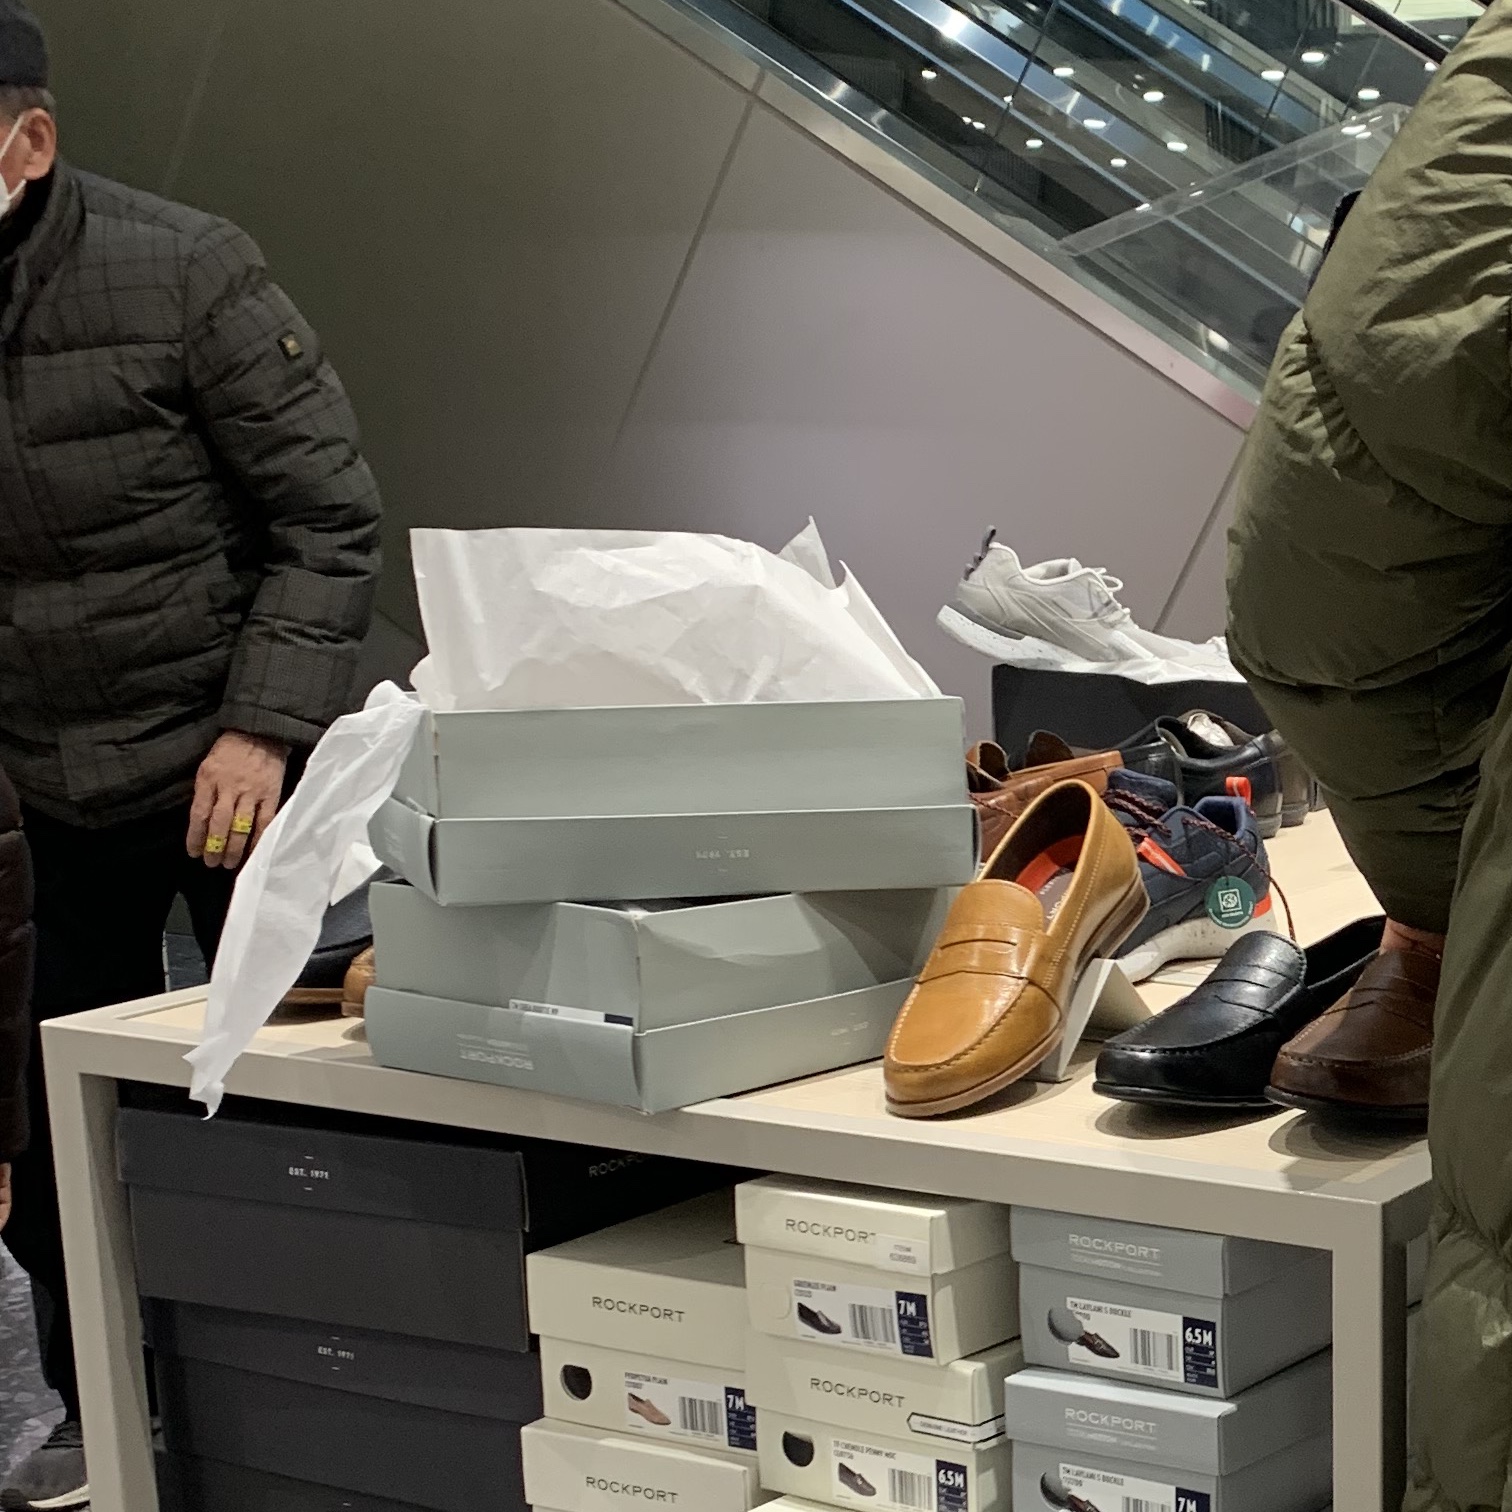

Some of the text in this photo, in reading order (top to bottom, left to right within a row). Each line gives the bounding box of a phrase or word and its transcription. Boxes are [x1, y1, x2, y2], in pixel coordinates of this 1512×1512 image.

[288, 1167, 308, 1177] EST.
[784, 1218, 877, 1244] ROCKPORT
[1068, 1233, 1161, 1260] ROCKPORT
[591, 1296, 686, 1324] ROCKPORT
[897, 1300, 917, 1318] 7M
[810, 1377, 906, 1409] ROCKPORT
[1064, 1407, 1156, 1434] ROCKPORT
[585, 1476, 679, 1504] ROCKPORT
